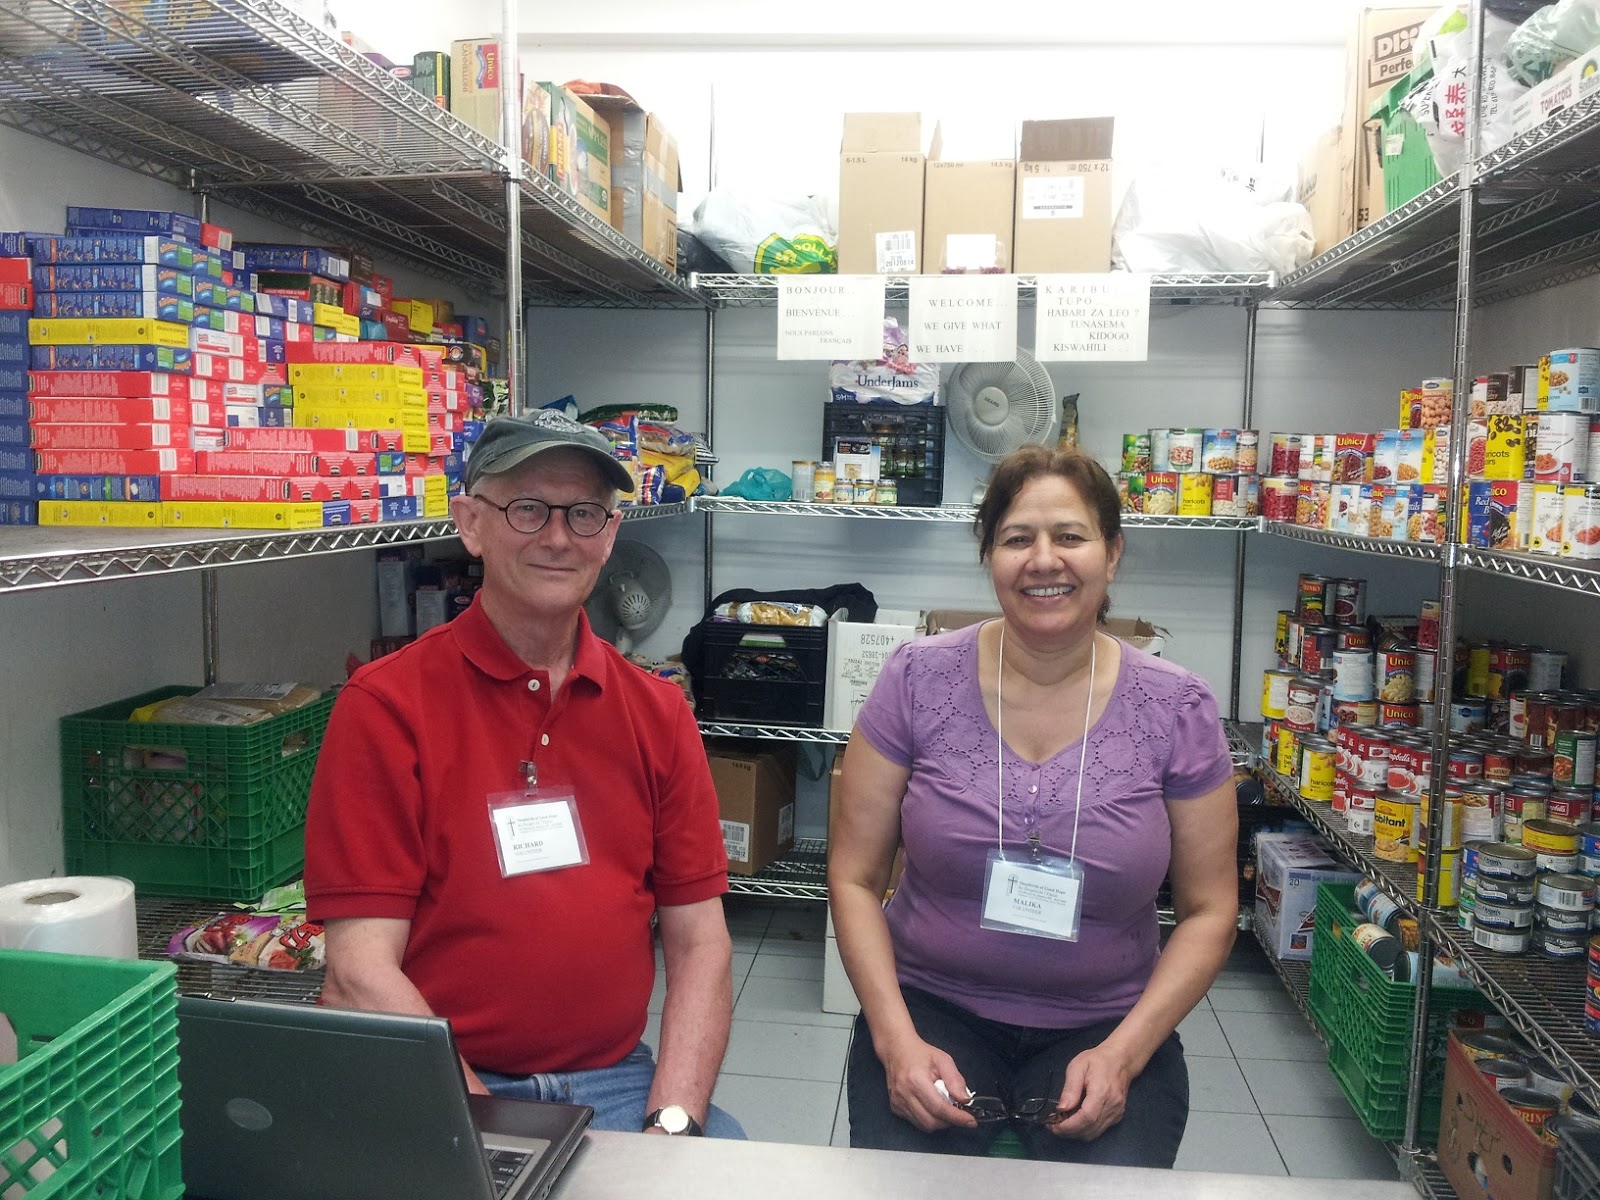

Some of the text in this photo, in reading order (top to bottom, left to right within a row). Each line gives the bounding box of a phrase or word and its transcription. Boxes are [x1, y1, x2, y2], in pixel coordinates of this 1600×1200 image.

[1377, 26, 1419, 59] DIX
[1380, 57, 1412, 77] Perfe
[1047, 308, 1086, 317] HABARI
[1090, 308, 1104, 317] ZA
[1109, 308, 1129, 317] LEO
[923, 321, 1001, 330] WE GIVE WHAT
[1070, 320, 1126, 329] TUNASEMA
[1089, 331, 1130, 340] KIDOGO
[916, 344, 964, 353] WE HAVE
[1053, 343, 1107, 352] KISWAHILI
[857, 374, 919, 391] UnderJams
[1150, 475, 1175, 484] Unico
[1492, 487, 1507, 496] ico
[1310, 778, 1334, 787] haricot
[1375, 815, 1406, 828] abitant
[513, 840, 544, 850] RICHARD
[1013, 898, 1042, 909] MALIKA
